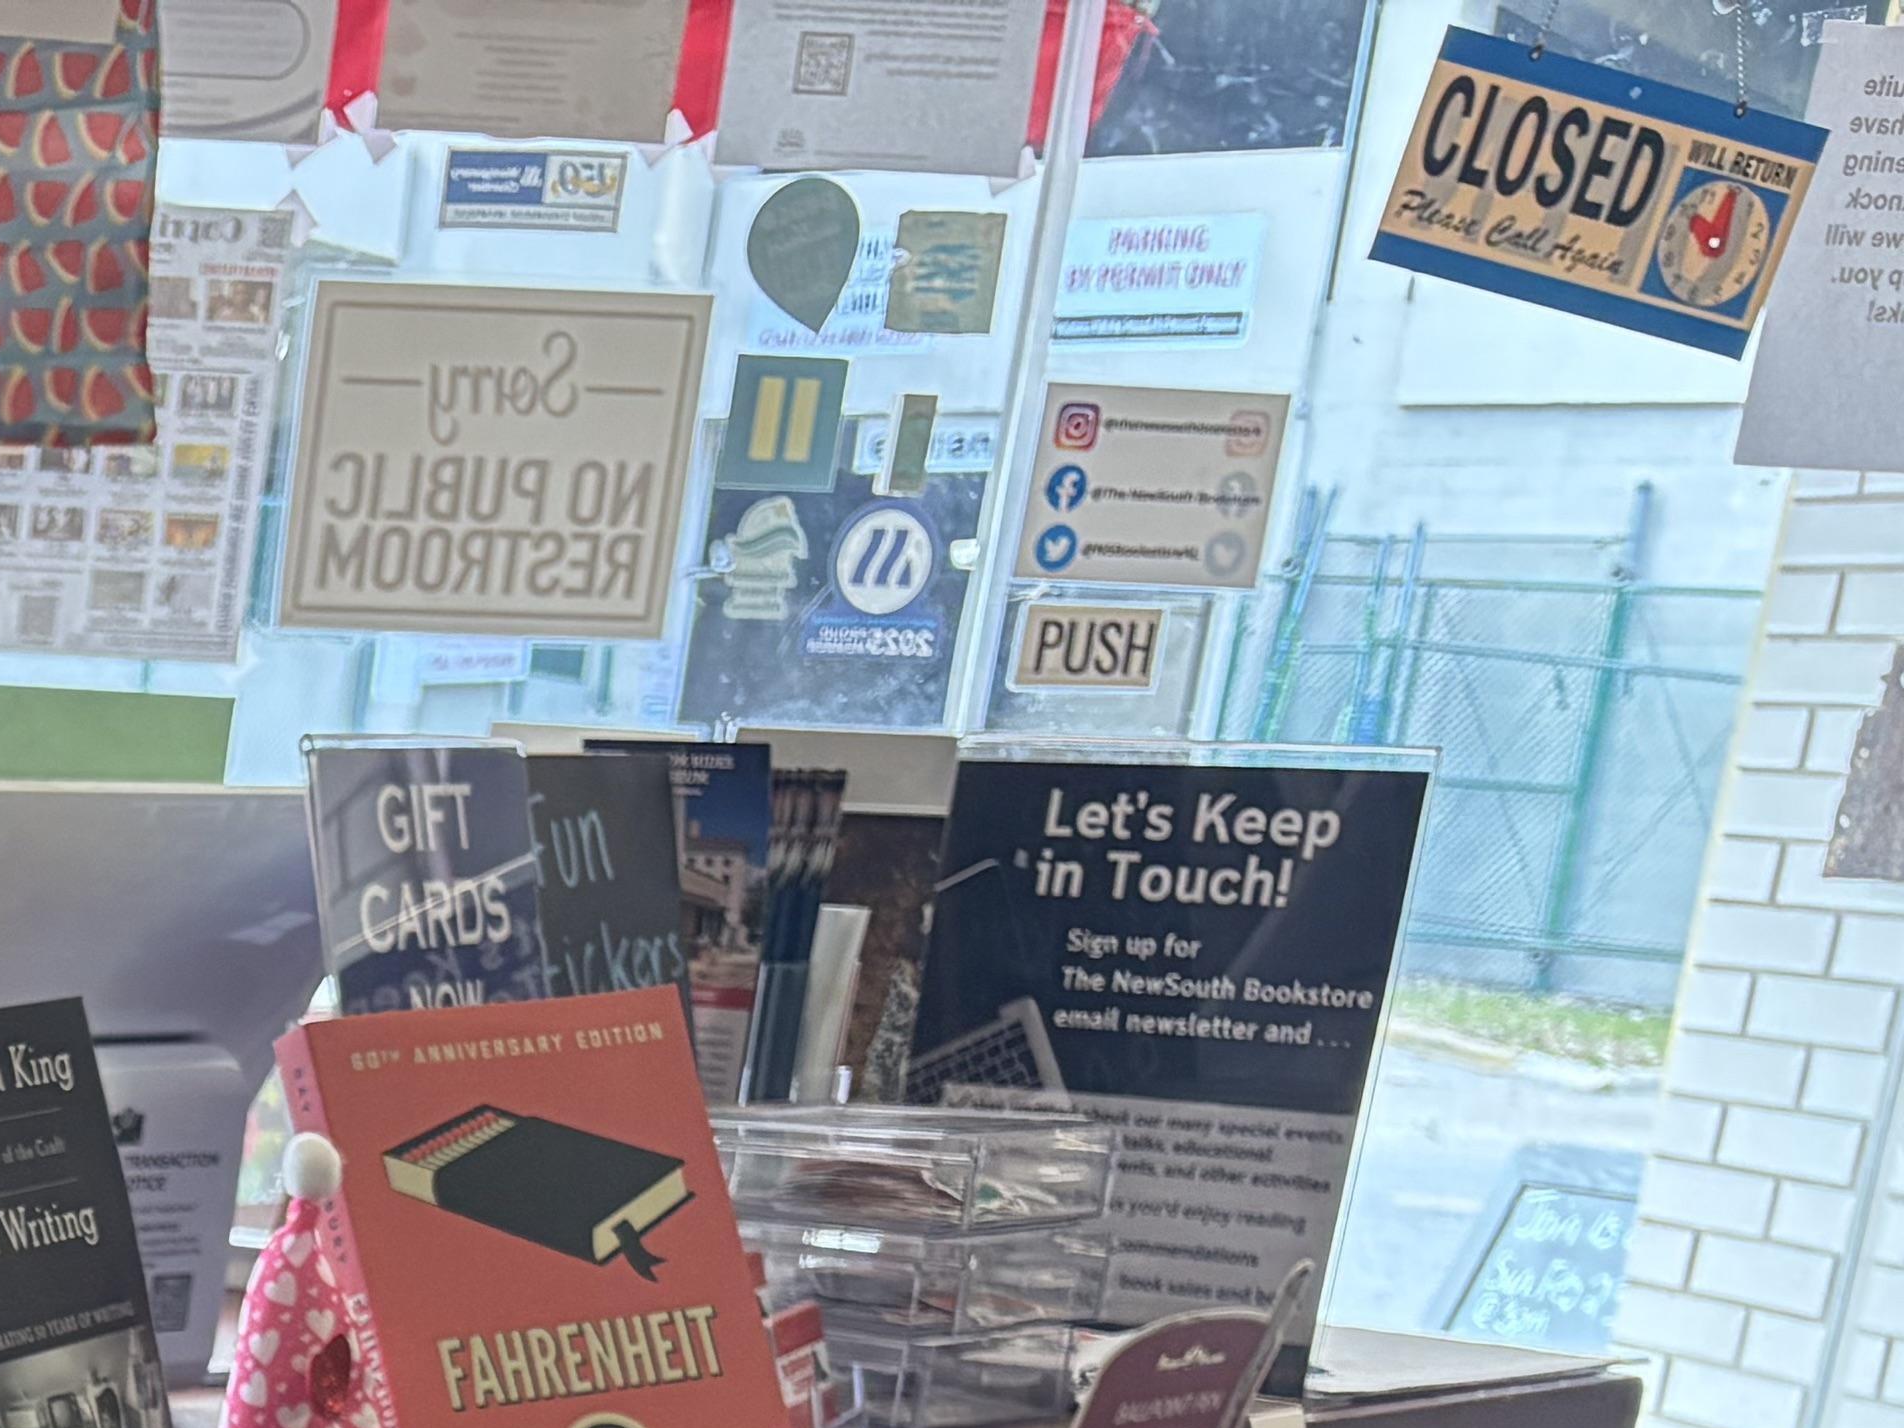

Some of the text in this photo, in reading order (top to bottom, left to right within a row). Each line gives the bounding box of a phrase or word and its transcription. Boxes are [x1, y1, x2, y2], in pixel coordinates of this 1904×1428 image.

[1421, 75, 1666, 228] CLOSED
[1687, 138, 1798, 189] WILL RETURN
[1394, 188, 1622, 277] Please Call Again
[1032, 618, 1154, 678] PUSH
[376, 783, 473, 854] GIFT
[1043, 787, 1342, 862] Let's Keep
[1035, 848, 1296, 908] in Touch!
[358, 876, 513, 954] CARDS
[1065, 927, 1203, 962] Sign up for
[1061, 965, 1375, 1011] The NewSouth Bookstore
[411, 1021, 665, 1067] ANNIVERSARY EDITION
[1052, 1005, 1314, 1047] email newsletter and
[5, 1041, 76, 1093] King
[436, 1304, 725, 1414] FAHRENHEIT
